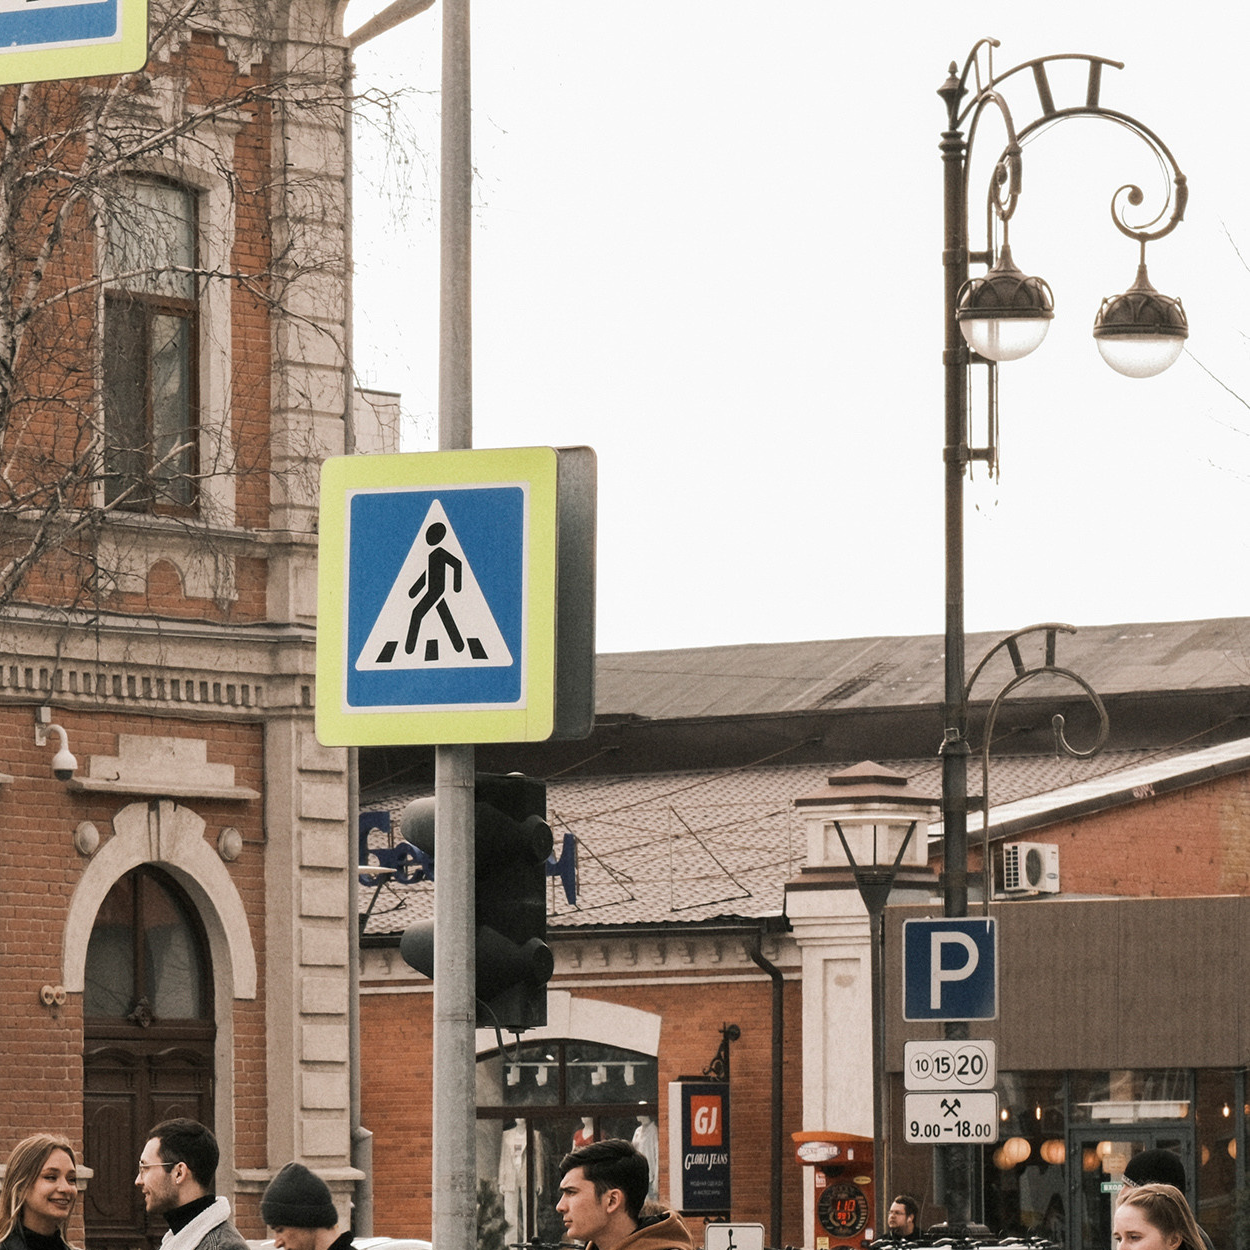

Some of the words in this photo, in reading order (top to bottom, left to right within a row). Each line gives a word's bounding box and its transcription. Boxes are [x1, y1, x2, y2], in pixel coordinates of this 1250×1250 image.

[930, 931, 979, 1010] P
[915, 1058, 929, 1072] 10
[934, 1056, 951, 1074] 15
[957, 1055, 983, 1075] 20
[694, 1106, 718, 1135] GJ
[684, 1153, 709, 1171] GLORIA
[707, 1153, 728, 1171] JEANS
